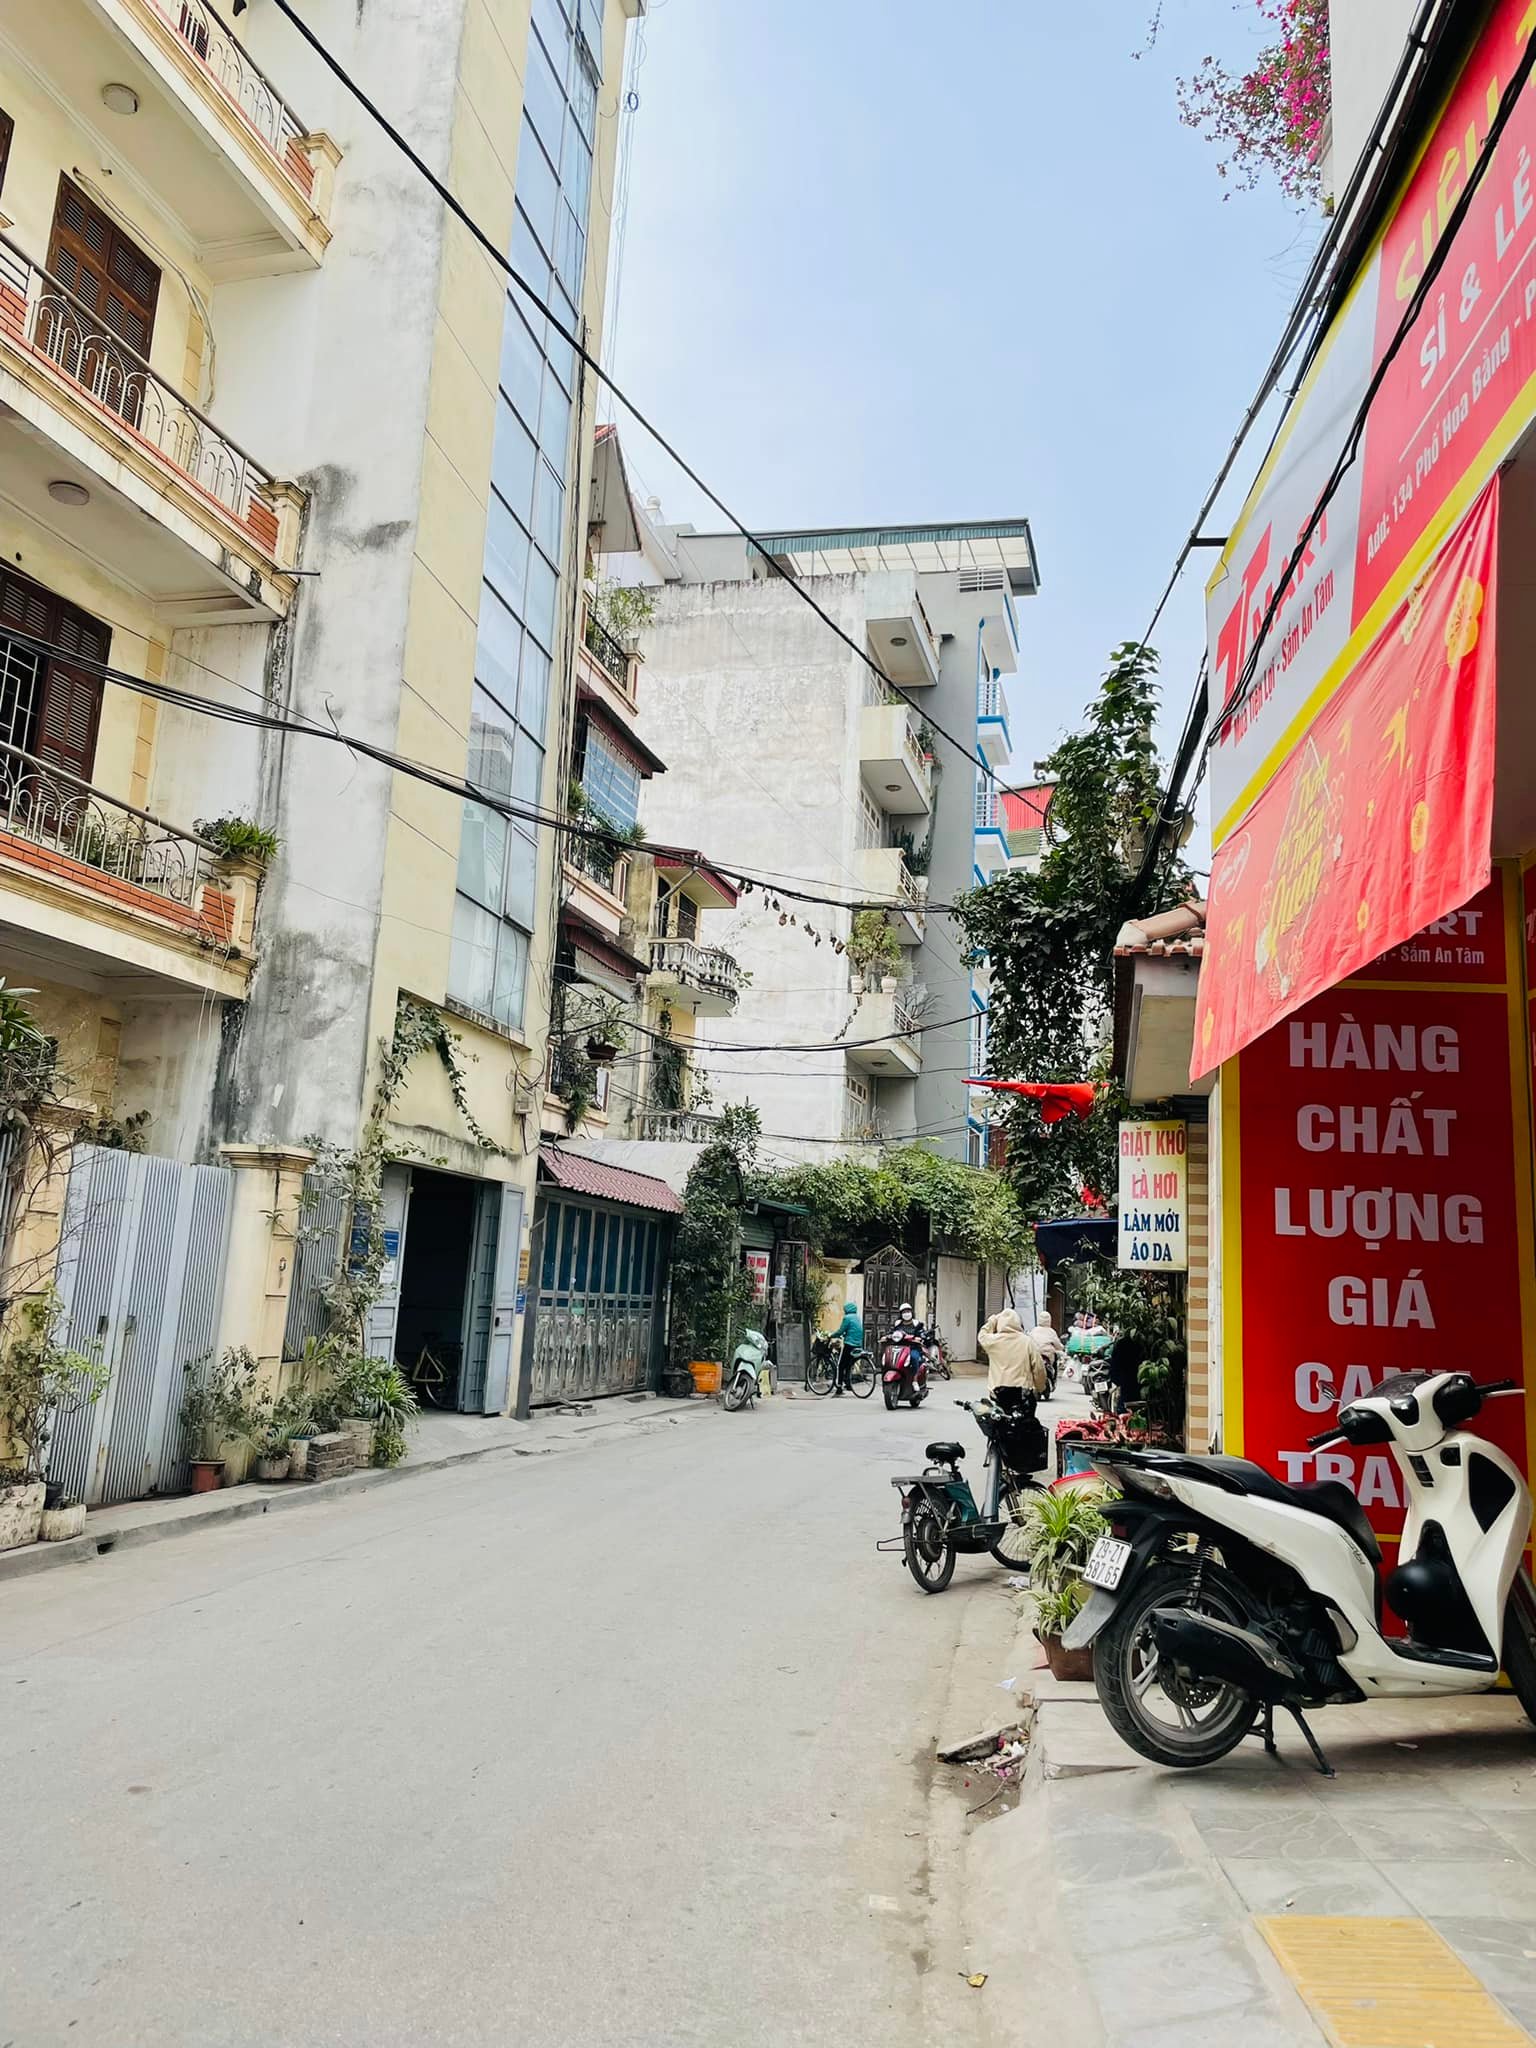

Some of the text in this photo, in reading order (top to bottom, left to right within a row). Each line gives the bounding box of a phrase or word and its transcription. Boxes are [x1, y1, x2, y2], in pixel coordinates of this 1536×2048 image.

[1459, 262, 1482, 322] &
[1367, 512, 1390, 565] Add:
[1392, 484, 1412, 523] 134
[1442, 391, 1469, 448] Hoa
[1281, 620, 1299, 673] Sắm
[1302, 603, 1312, 644] An
[1314, 568, 1334, 621] Tâm
[1400, 943, 1431, 963] Sắm
[1435, 947, 1453, 963] An
[1456, 947, 1485, 964] Tâm
[1289, 1013, 1460, 1072] HÀNG
[1121, 1124, 1186, 1162] GIẶT KHÔ
[1297, 1091, 1457, 1156] CHẤT
[1131, 1168, 1178, 1199] LÀ HƠI
[1124, 1208, 1180, 1232] LÀM MỚI
[1275, 1185, 1484, 1250] LƯỢNG
[1130, 1236, 1172, 1261] ÁO DA
[1328, 1268, 1436, 1328] GIÁ
